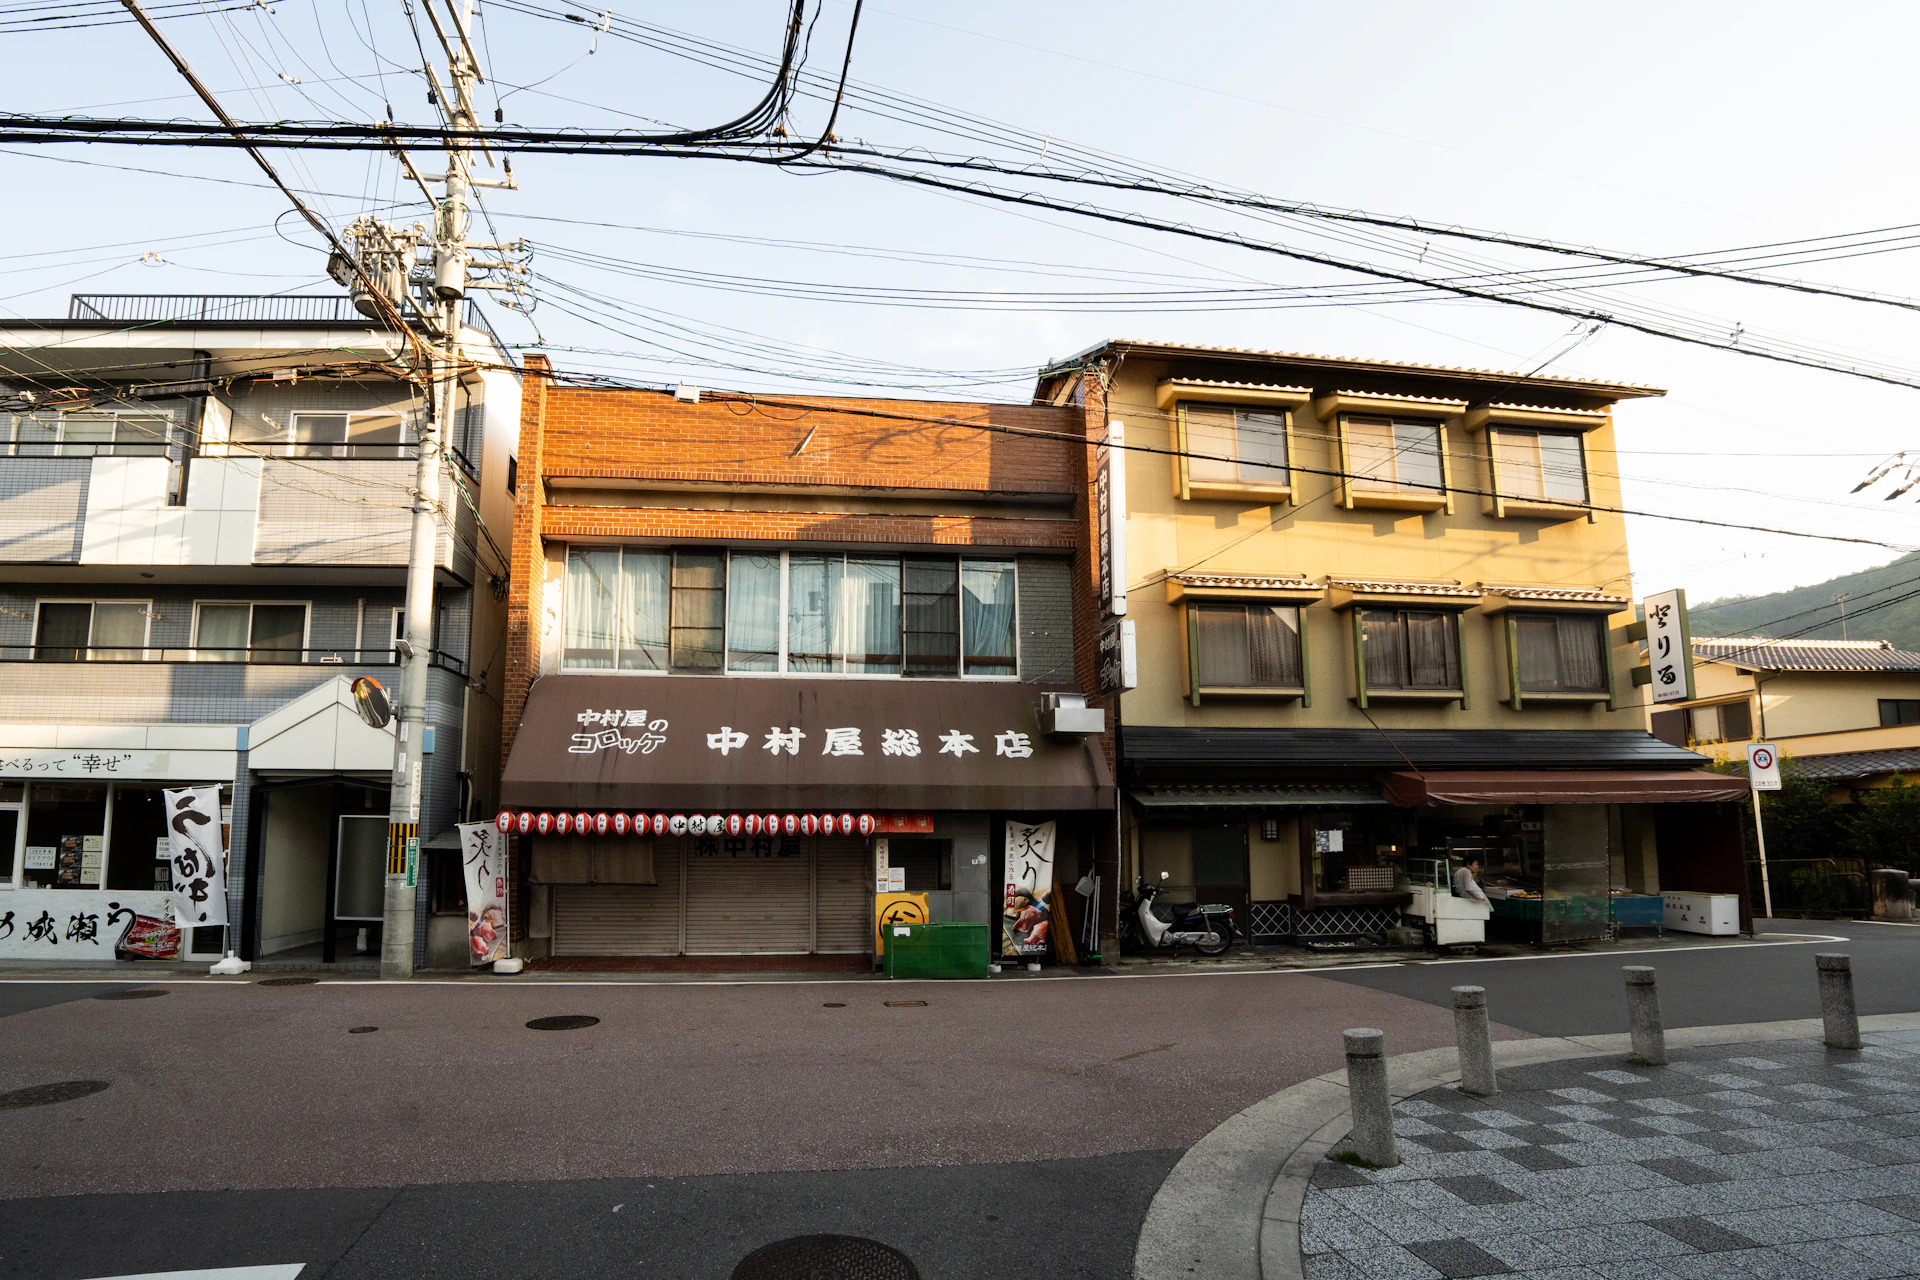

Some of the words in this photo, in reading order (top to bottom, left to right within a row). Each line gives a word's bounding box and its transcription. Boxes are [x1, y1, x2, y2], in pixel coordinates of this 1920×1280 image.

[577, 708, 669, 732] 中村屋の
[568, 728, 667, 754] コロッケ
[706, 726, 1034, 758] 中村屋総本店
[673, 819, 725, 834] 中村屋
[1018, 827, 1053, 896] 炙り
[1007, 885, 1016, 907] 寿司
